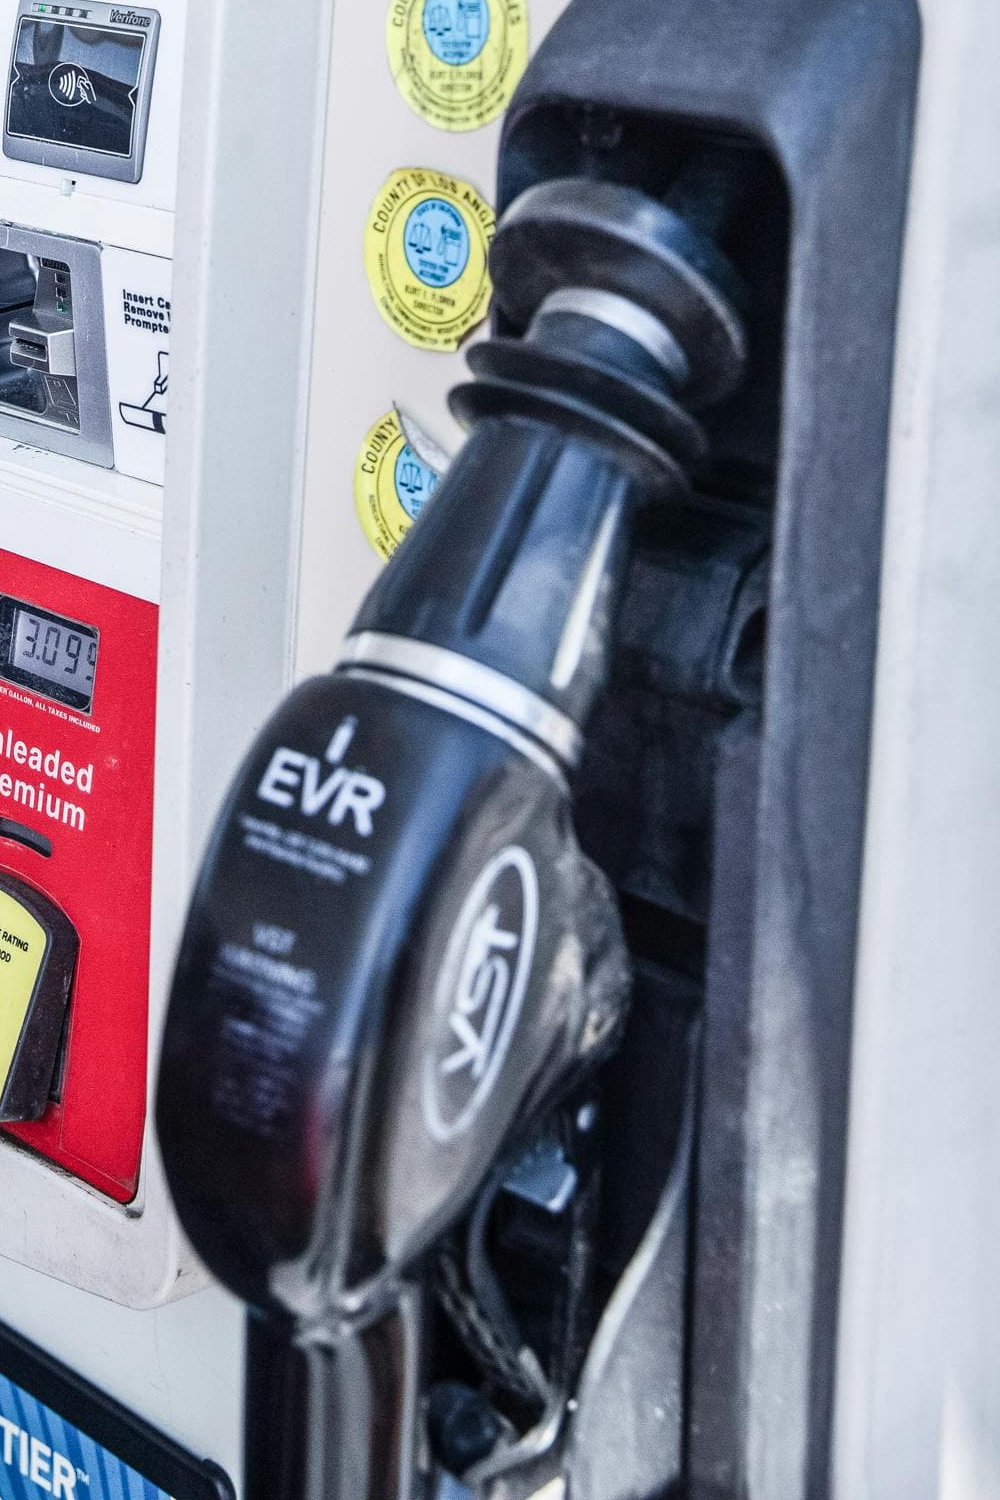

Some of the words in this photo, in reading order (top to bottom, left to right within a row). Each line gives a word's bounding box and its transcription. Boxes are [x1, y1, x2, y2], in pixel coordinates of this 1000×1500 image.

[110, 8, 152, 28] Verifone
[373, 179, 412, 234] COUNTY
[123, 289, 153, 306] Insert
[157, 297, 171, 310] Ca
[124, 301, 164, 321] Remove
[124, 313, 169, 334] Prompte
[361, 417, 398, 474] COUNTY
[35, 701, 47, 712] ALL
[48, 706, 68, 720] TAXES
[68, 714, 101, 734] INCLUDED
[257, 746, 386, 837] EVR
[1, 928, 29, 952] RATING
[439, 902, 519, 1080] VST
